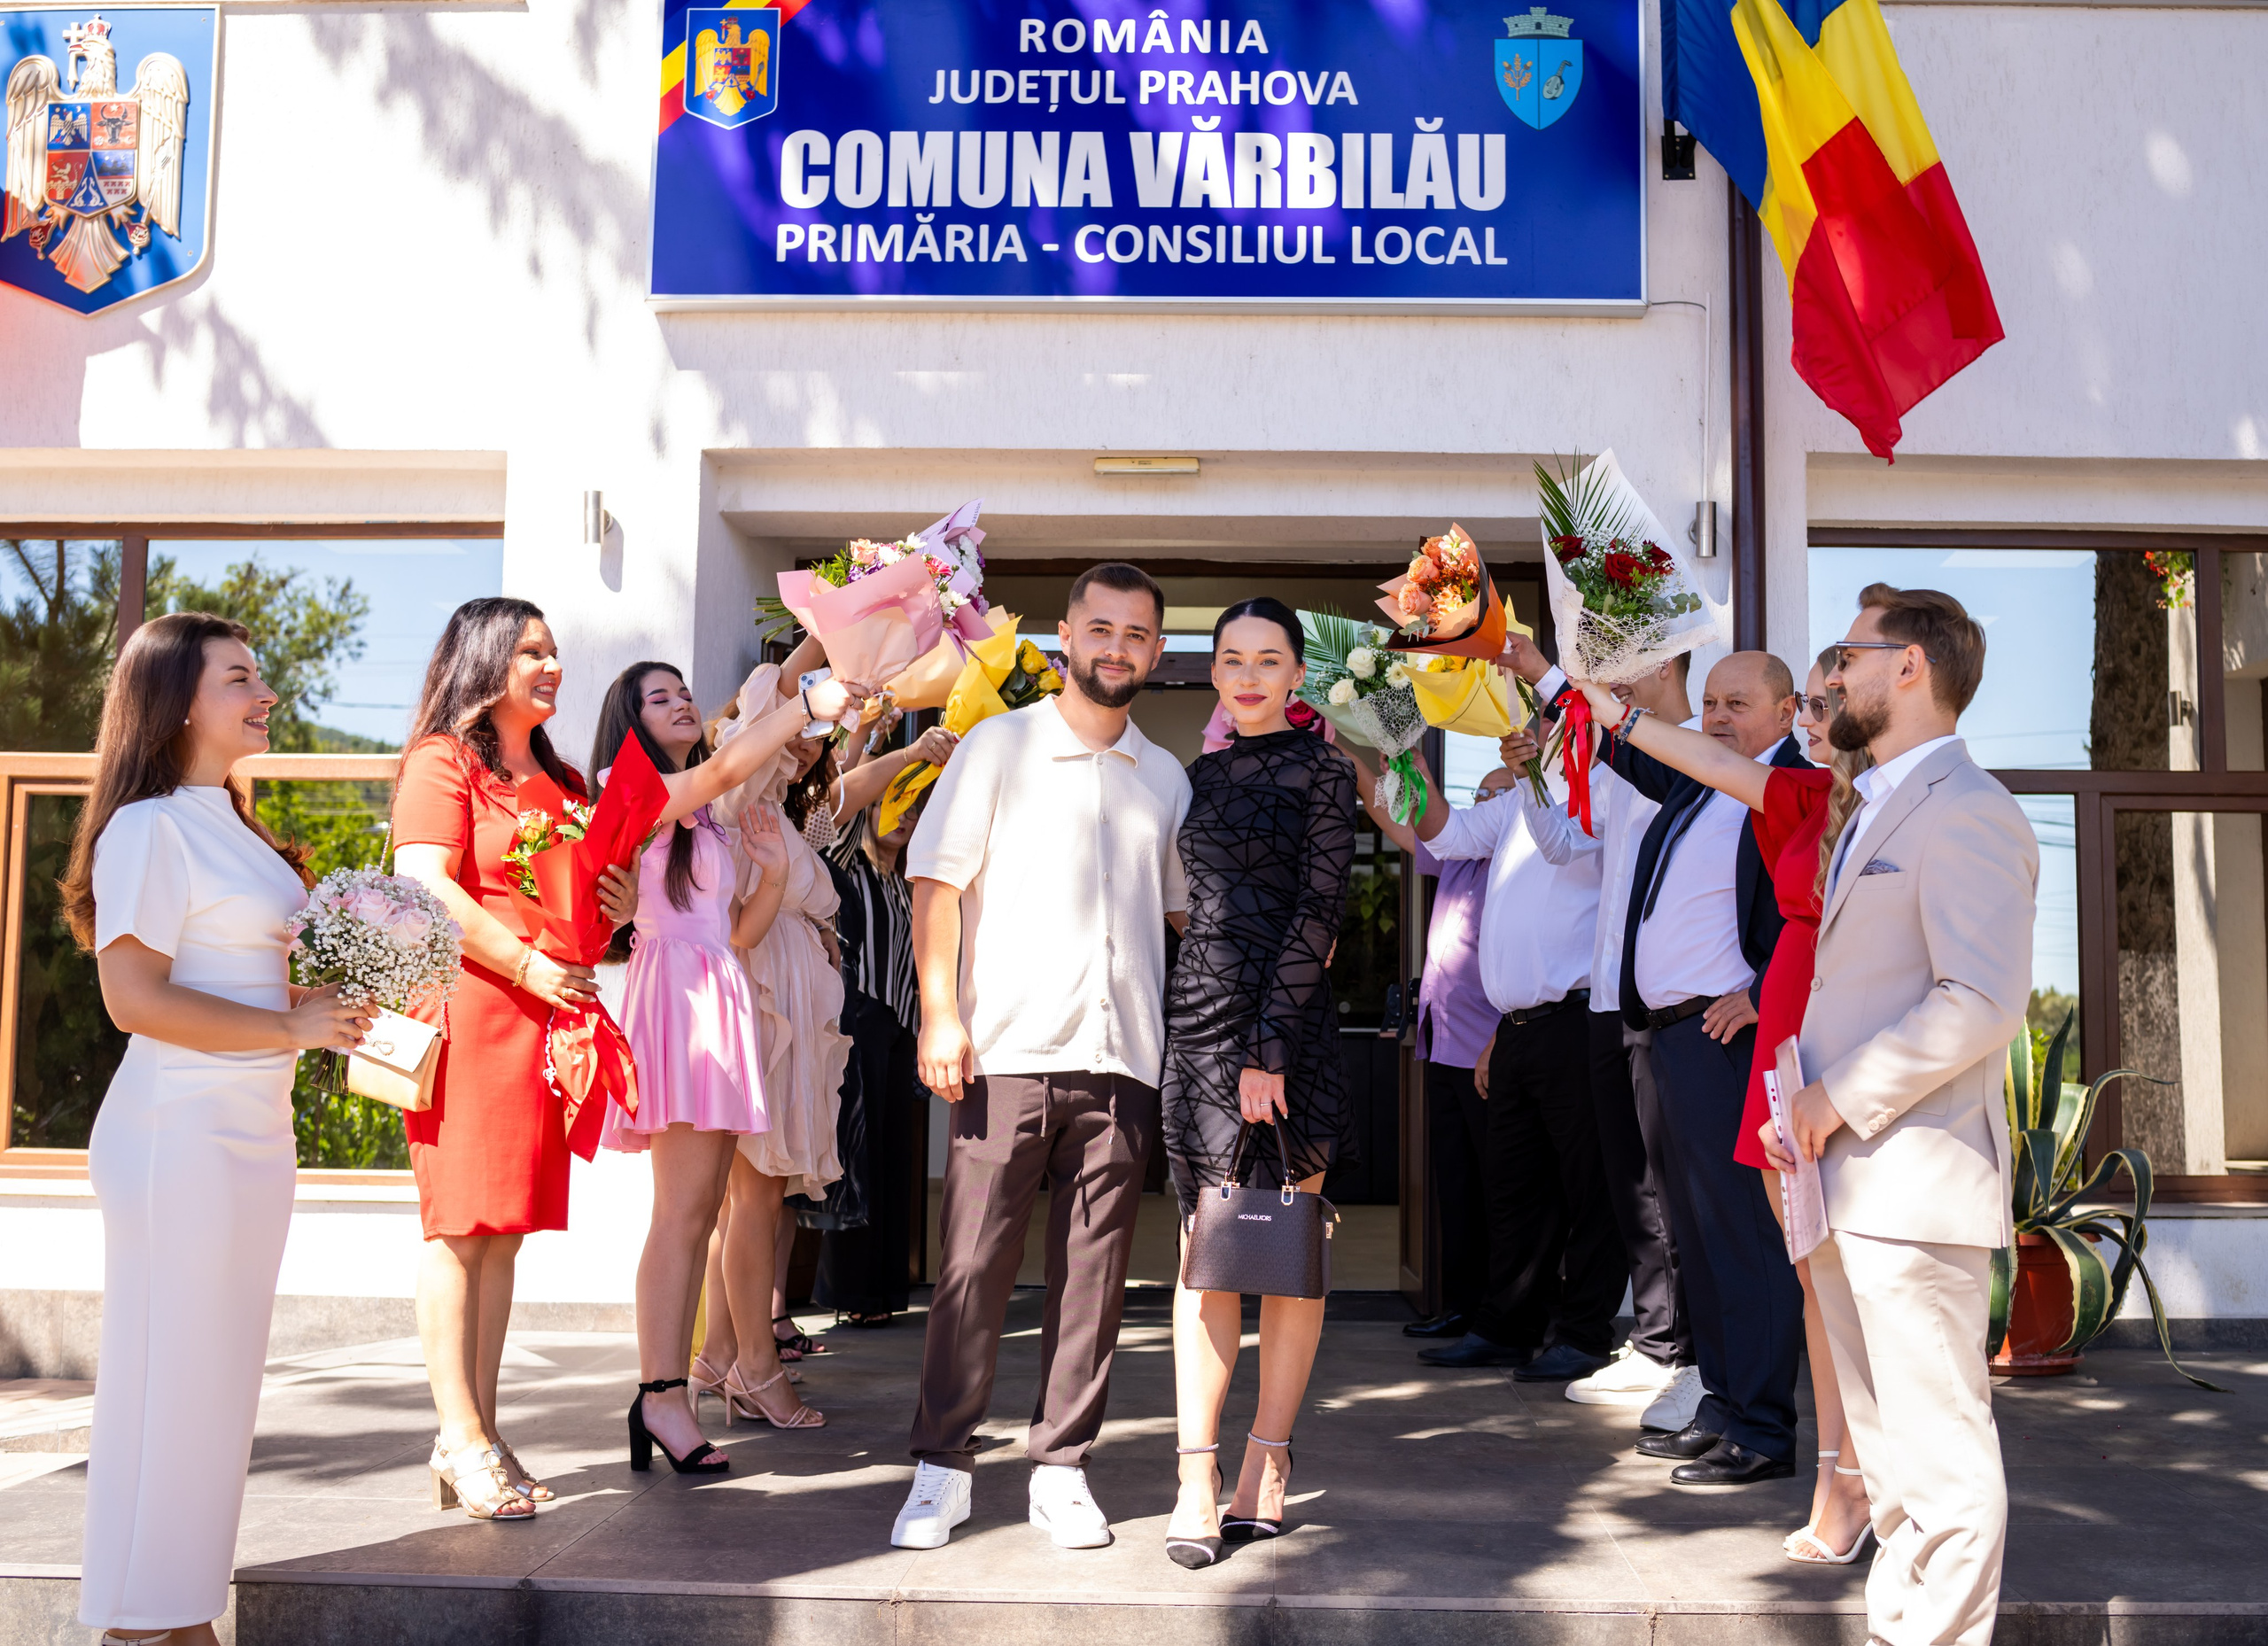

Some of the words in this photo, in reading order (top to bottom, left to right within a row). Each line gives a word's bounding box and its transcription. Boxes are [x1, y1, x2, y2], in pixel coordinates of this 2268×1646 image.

[1020, 9, 1270, 54] ROMÂNIA
[928, 69, 1126, 113] JUDEȚUL
[1138, 69, 1359, 105] PRAHOVA
[780, 129, 1114, 210] COMUNA
[1129, 114, 1507, 212] VĂRBILĂU
[776, 214, 1029, 264] PRIMĂRIA
[1041, 243, 1060, 252] -
[1074, 222, 1336, 265] CONSILIUL
[1351, 225, 1509, 267] LOCAL
